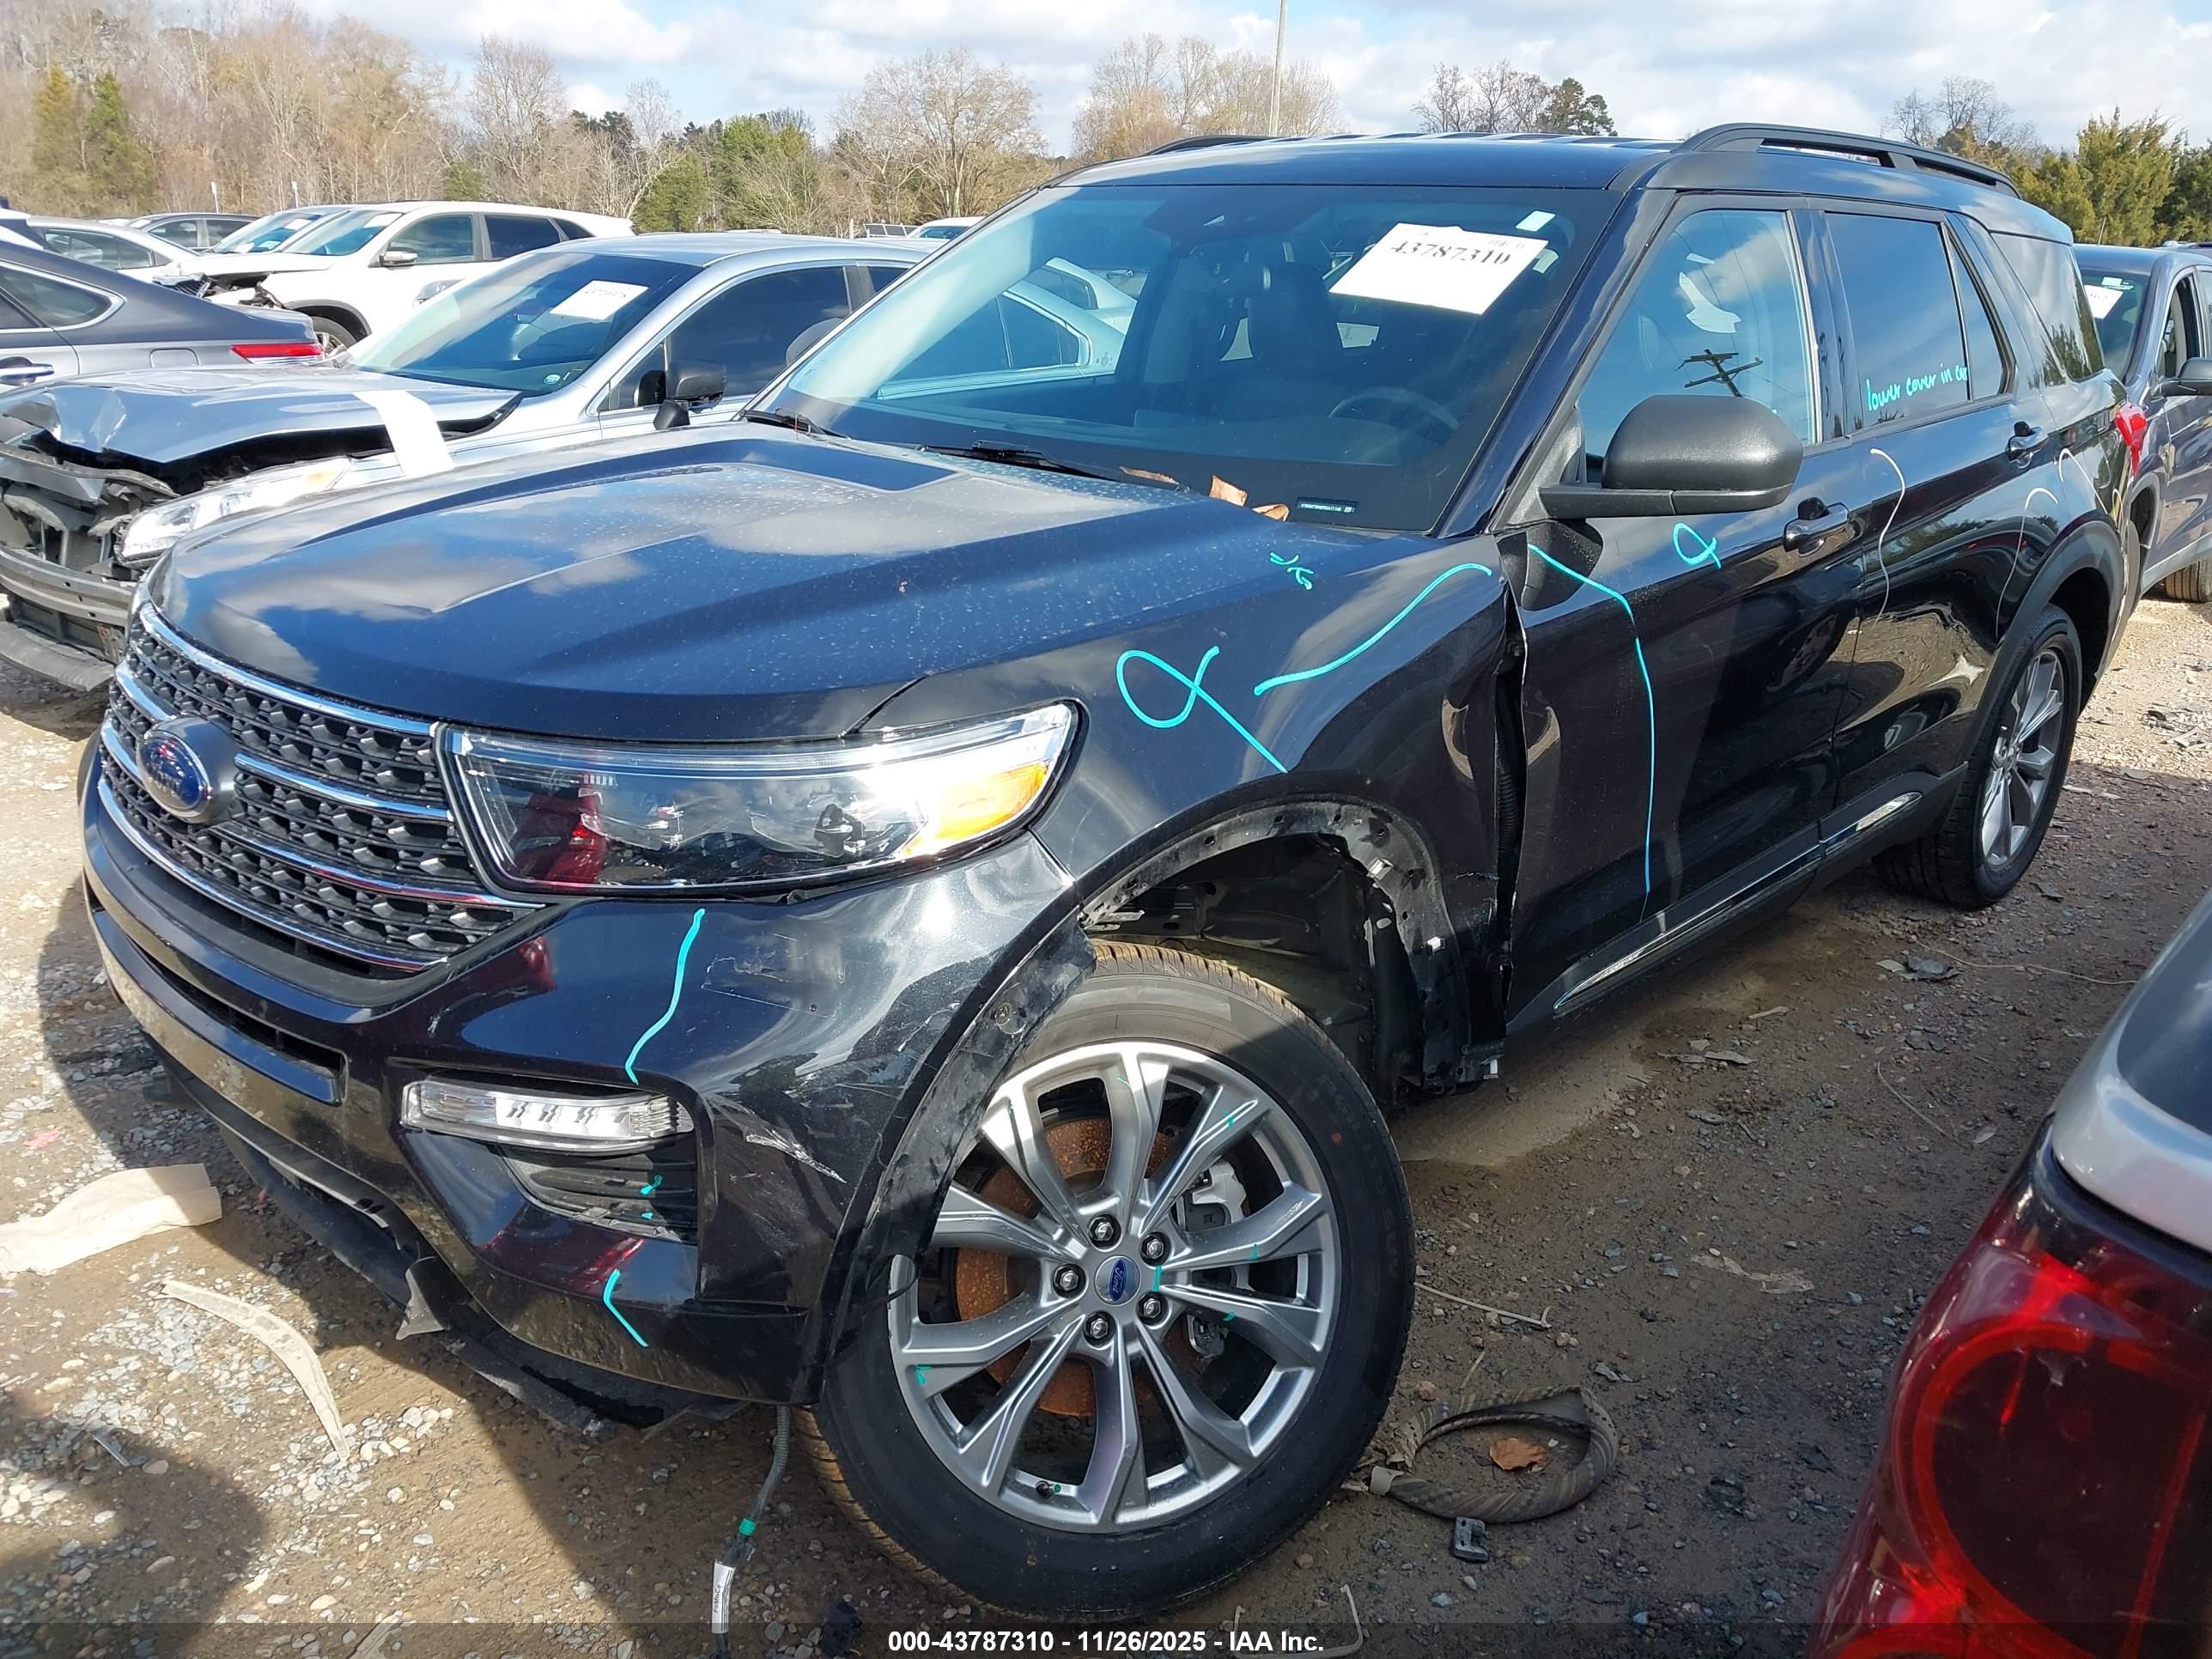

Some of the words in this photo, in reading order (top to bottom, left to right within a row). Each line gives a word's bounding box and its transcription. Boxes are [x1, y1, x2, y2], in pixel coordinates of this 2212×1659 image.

[1390, 240, 1511, 264] 43787310
[1865, 379, 1900, 410] lower
[1905, 374, 1937, 397] cover
[1939, 362, 1953, 385] in
[713, 1583, 721, 1613] FoMoCo
